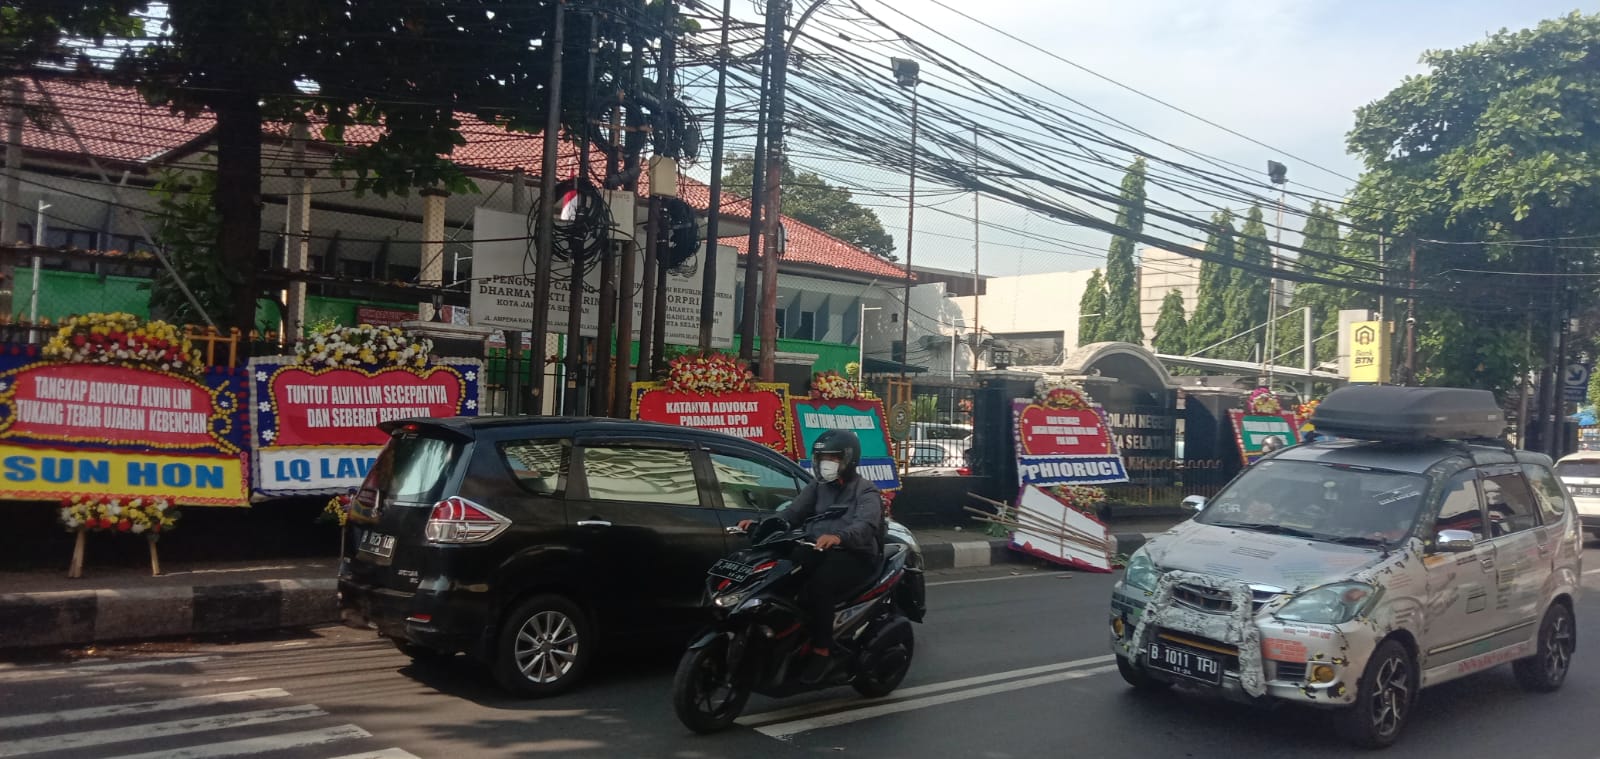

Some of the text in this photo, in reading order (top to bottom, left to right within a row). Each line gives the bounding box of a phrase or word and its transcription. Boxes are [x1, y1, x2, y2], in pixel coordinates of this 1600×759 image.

[35, 376, 192, 410] TANGKAP ADVOKAT ALVIN LIM
[286, 385, 328, 404] TUNTUT
[384, 385, 448, 404] SECEPATNYA
[16, 399, 207, 434] TUKANG TEBAR UJARAN KEBENCIAN
[307, 408, 330, 428] DAN
[332, 407, 377, 428] SEBERAT
[666, 401, 759, 414] KATANYA ADVOKAT
[680, 414, 748, 427] PADAHAL DPO
[4, 455, 224, 489] SUN HON
[274, 459, 311, 482] LQ
[1151, 645, 1218, 674] B 1011 TFU
